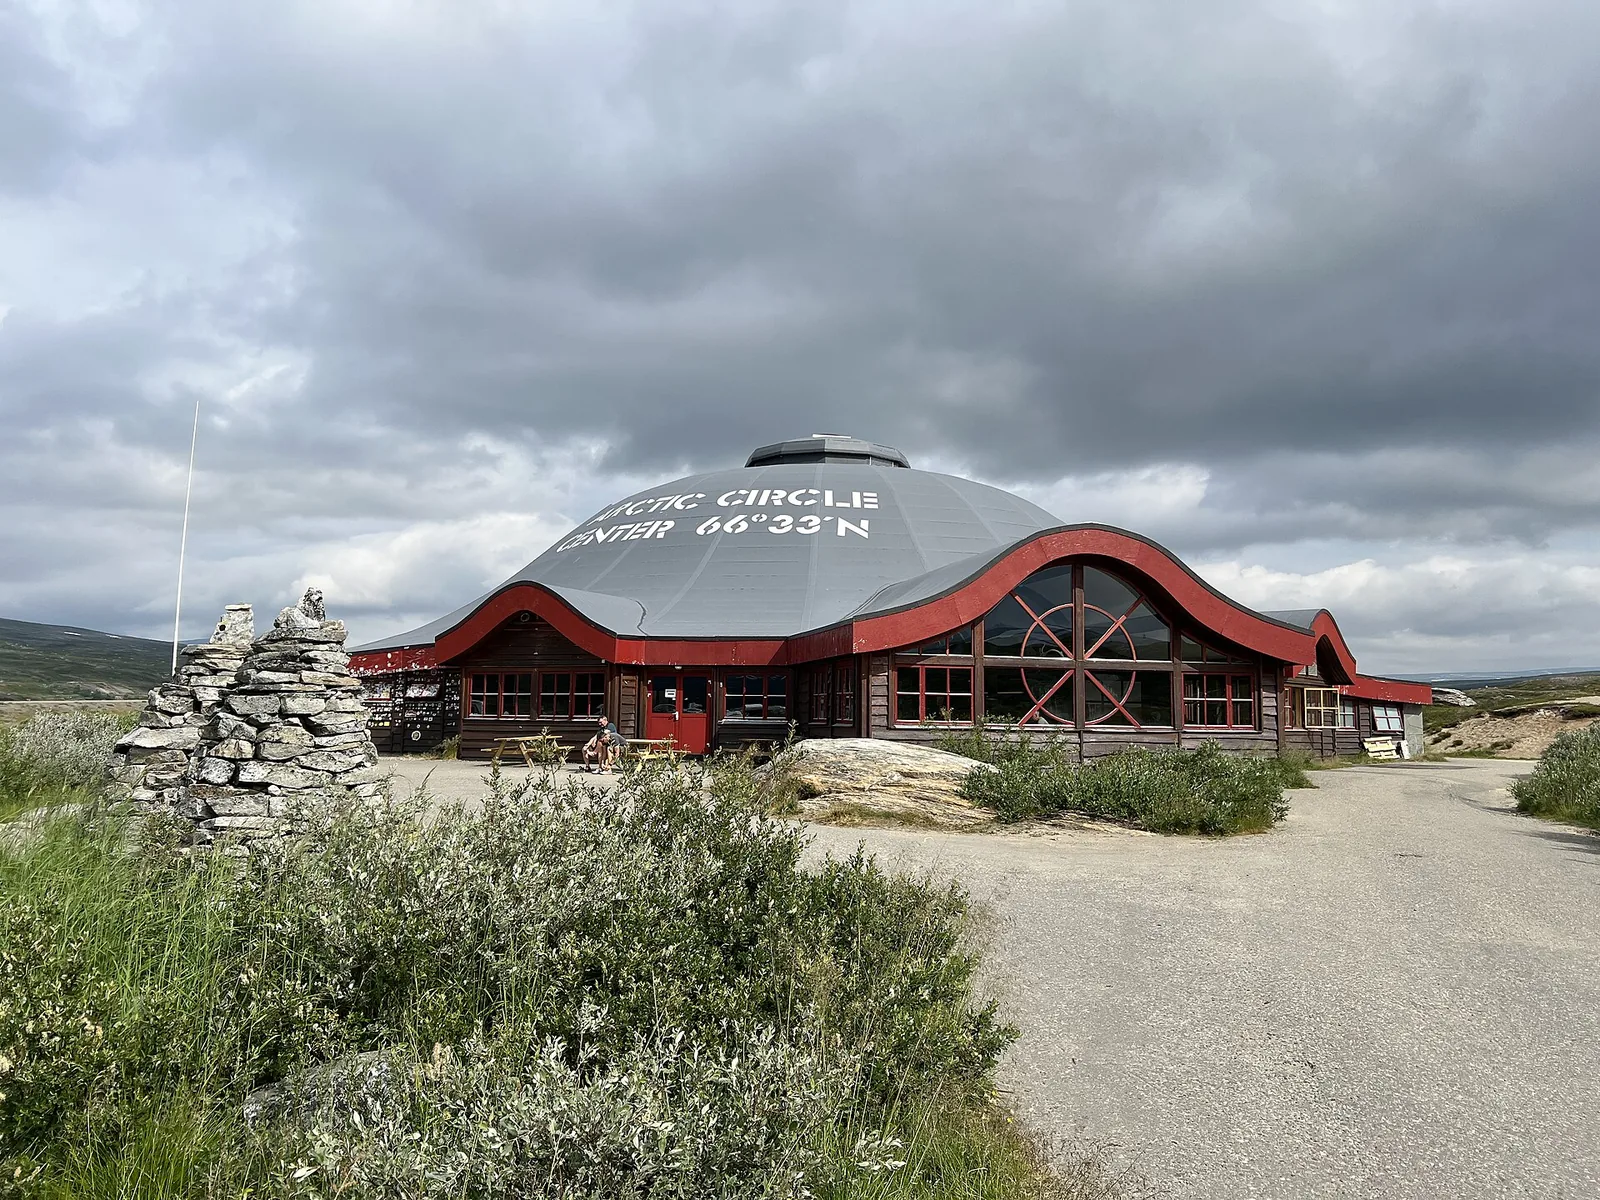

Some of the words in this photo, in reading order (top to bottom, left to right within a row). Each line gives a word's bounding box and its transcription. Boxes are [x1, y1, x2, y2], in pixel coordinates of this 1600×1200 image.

[586, 492, 707, 527] ARCTIC
[716, 488, 879, 509] CIRCLE
[556, 520, 676, 553] CENTER
